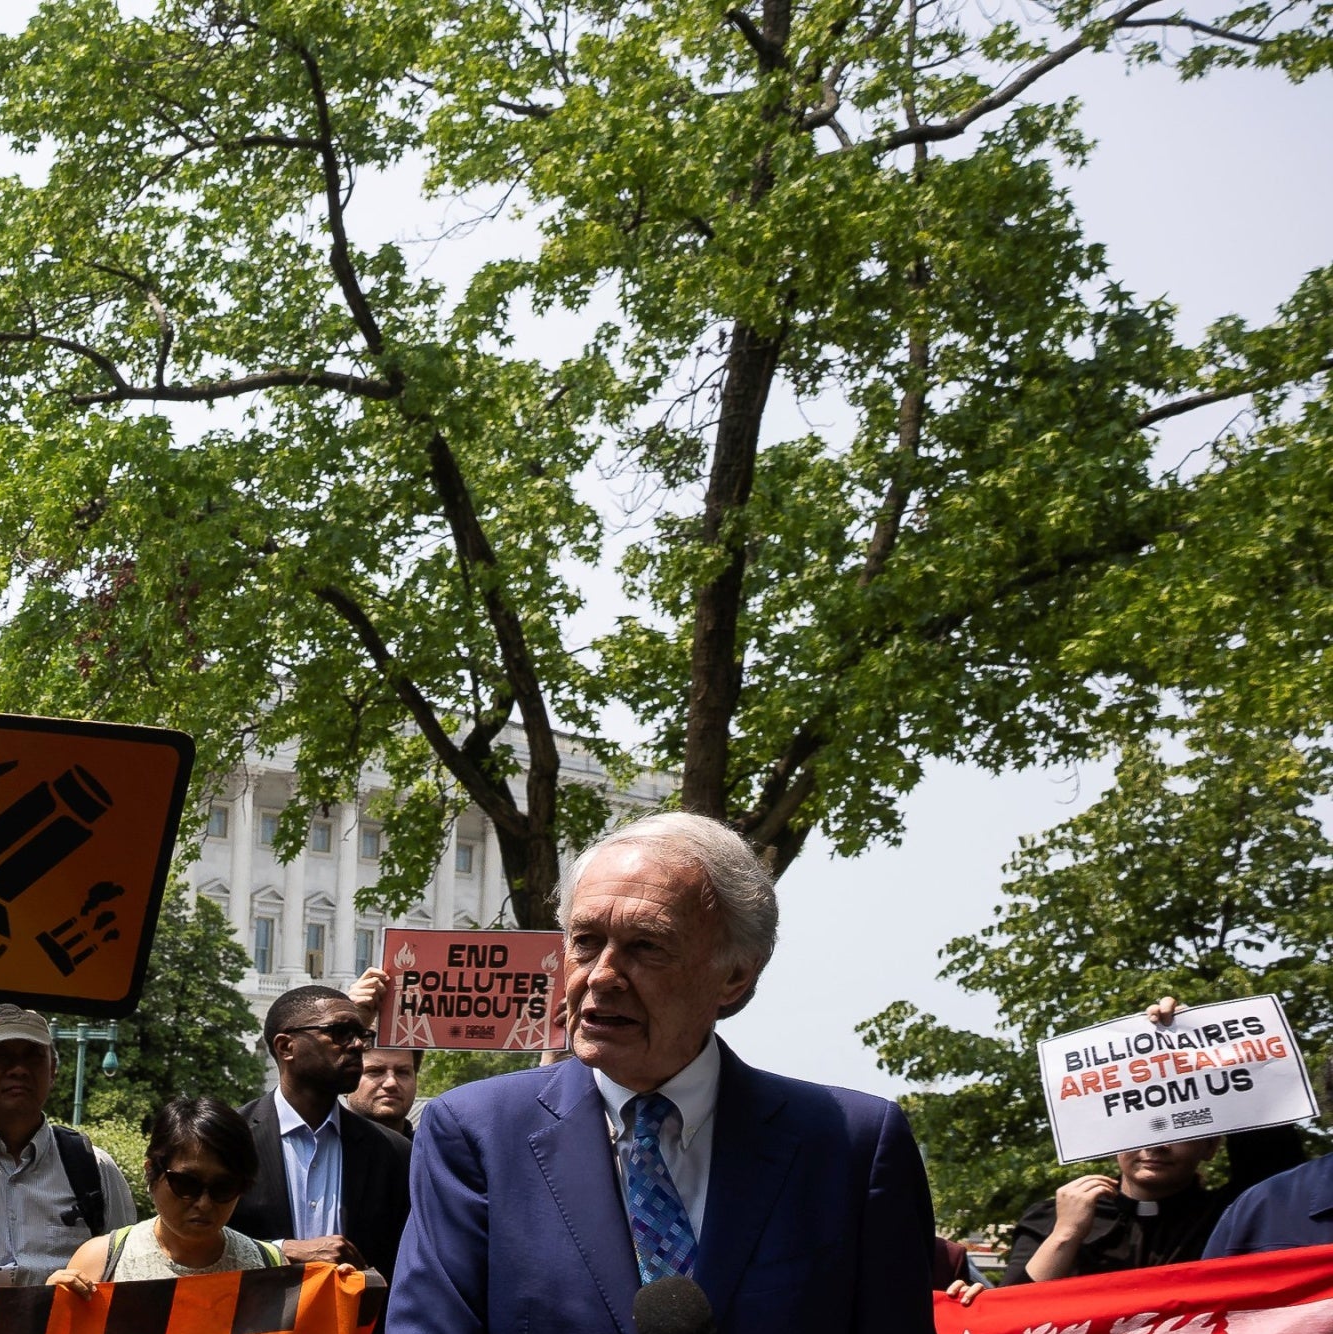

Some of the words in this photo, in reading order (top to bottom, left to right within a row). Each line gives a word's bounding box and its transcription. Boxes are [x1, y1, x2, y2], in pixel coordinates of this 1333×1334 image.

[448, 944, 508, 968] END
[403, 971, 549, 994] POLLUTER
[400, 994, 546, 1019] HANDOUTS
[1065, 1016, 1265, 1073] BILLIONAIRES
[1060, 1065, 1122, 1101] ARE
[1132, 1036, 1287, 1084] STEALING
[1103, 1077, 1199, 1117] FROM
[1205, 1068, 1254, 1096] US
